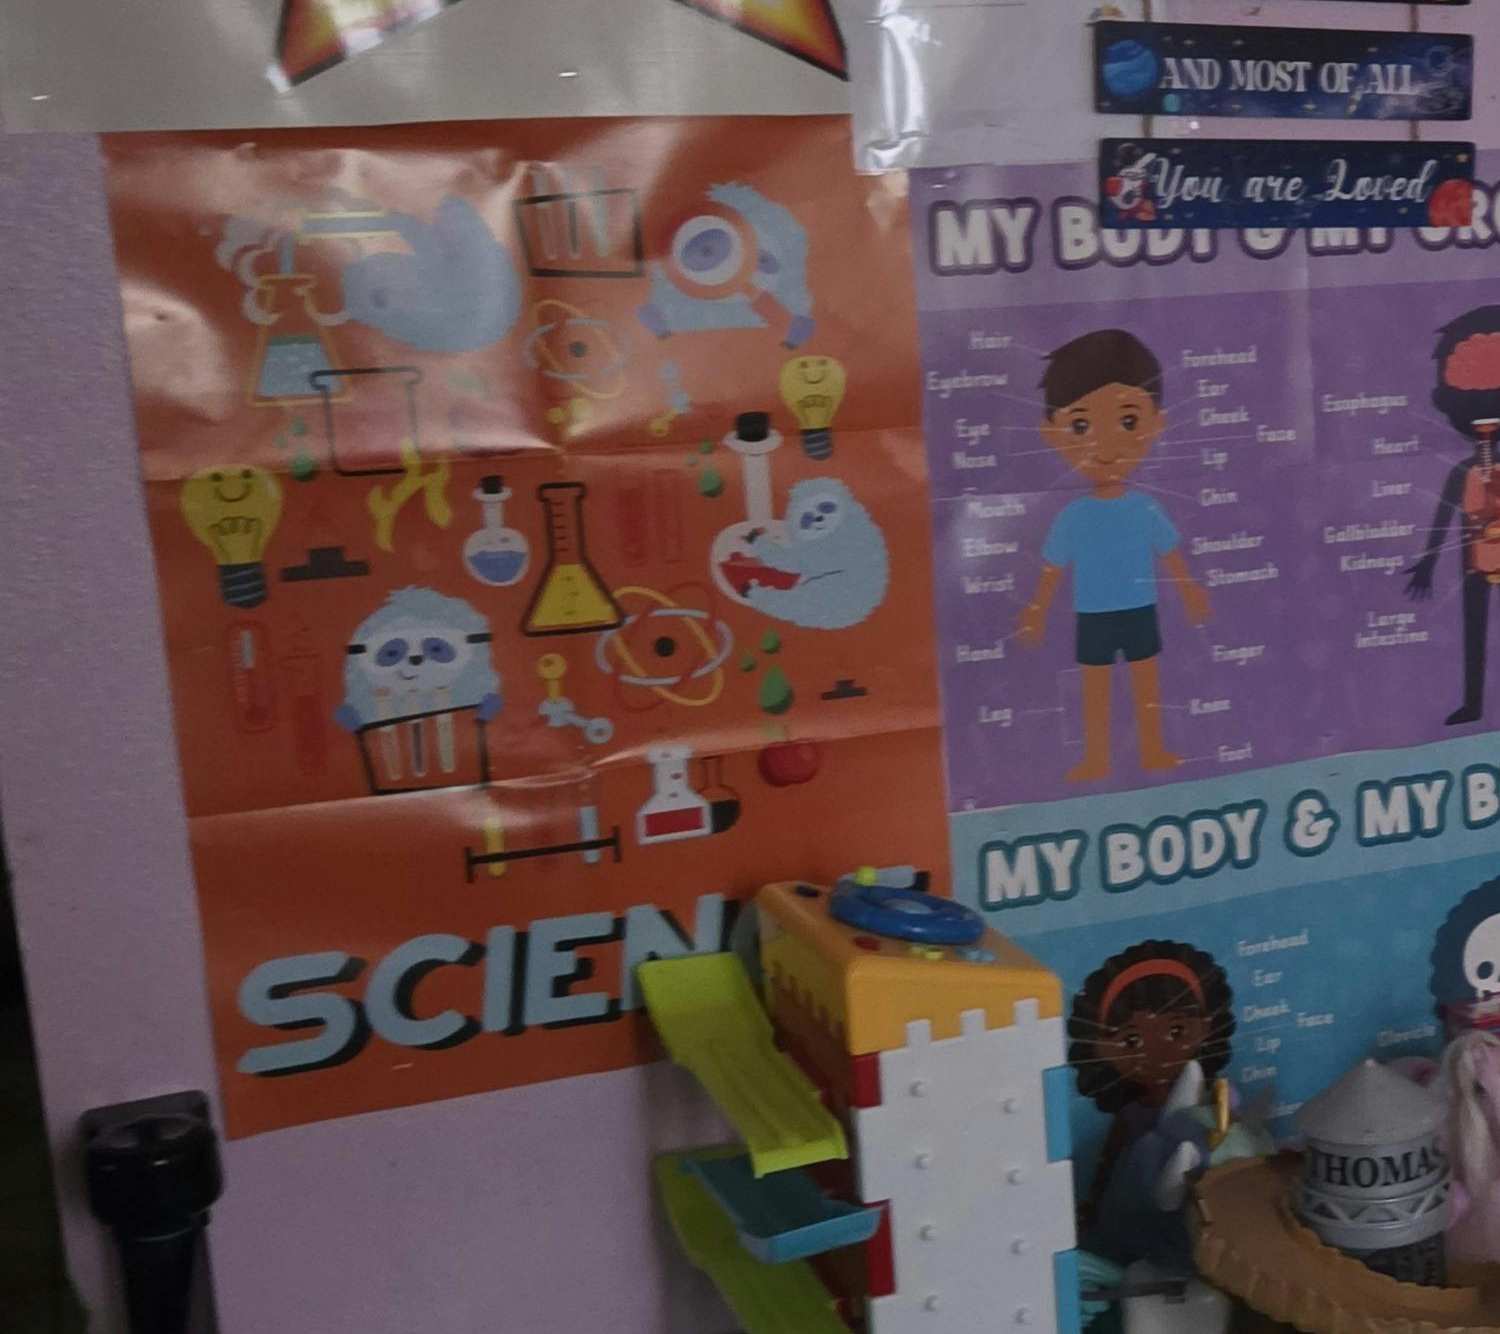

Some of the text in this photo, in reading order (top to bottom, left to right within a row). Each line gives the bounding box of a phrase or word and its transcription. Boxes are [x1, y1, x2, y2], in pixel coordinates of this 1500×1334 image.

[1158, 56, 1422, 97] AND MOST OF ALL
[1151, 156, 1438, 209] You are Loved
[930, 199, 1038, 274] MY
[982, 832, 1086, 908] MY
[1104, 800, 1266, 891] BODY
[1286, 792, 1335, 853] &
[1358, 771, 1450, 846] MY
